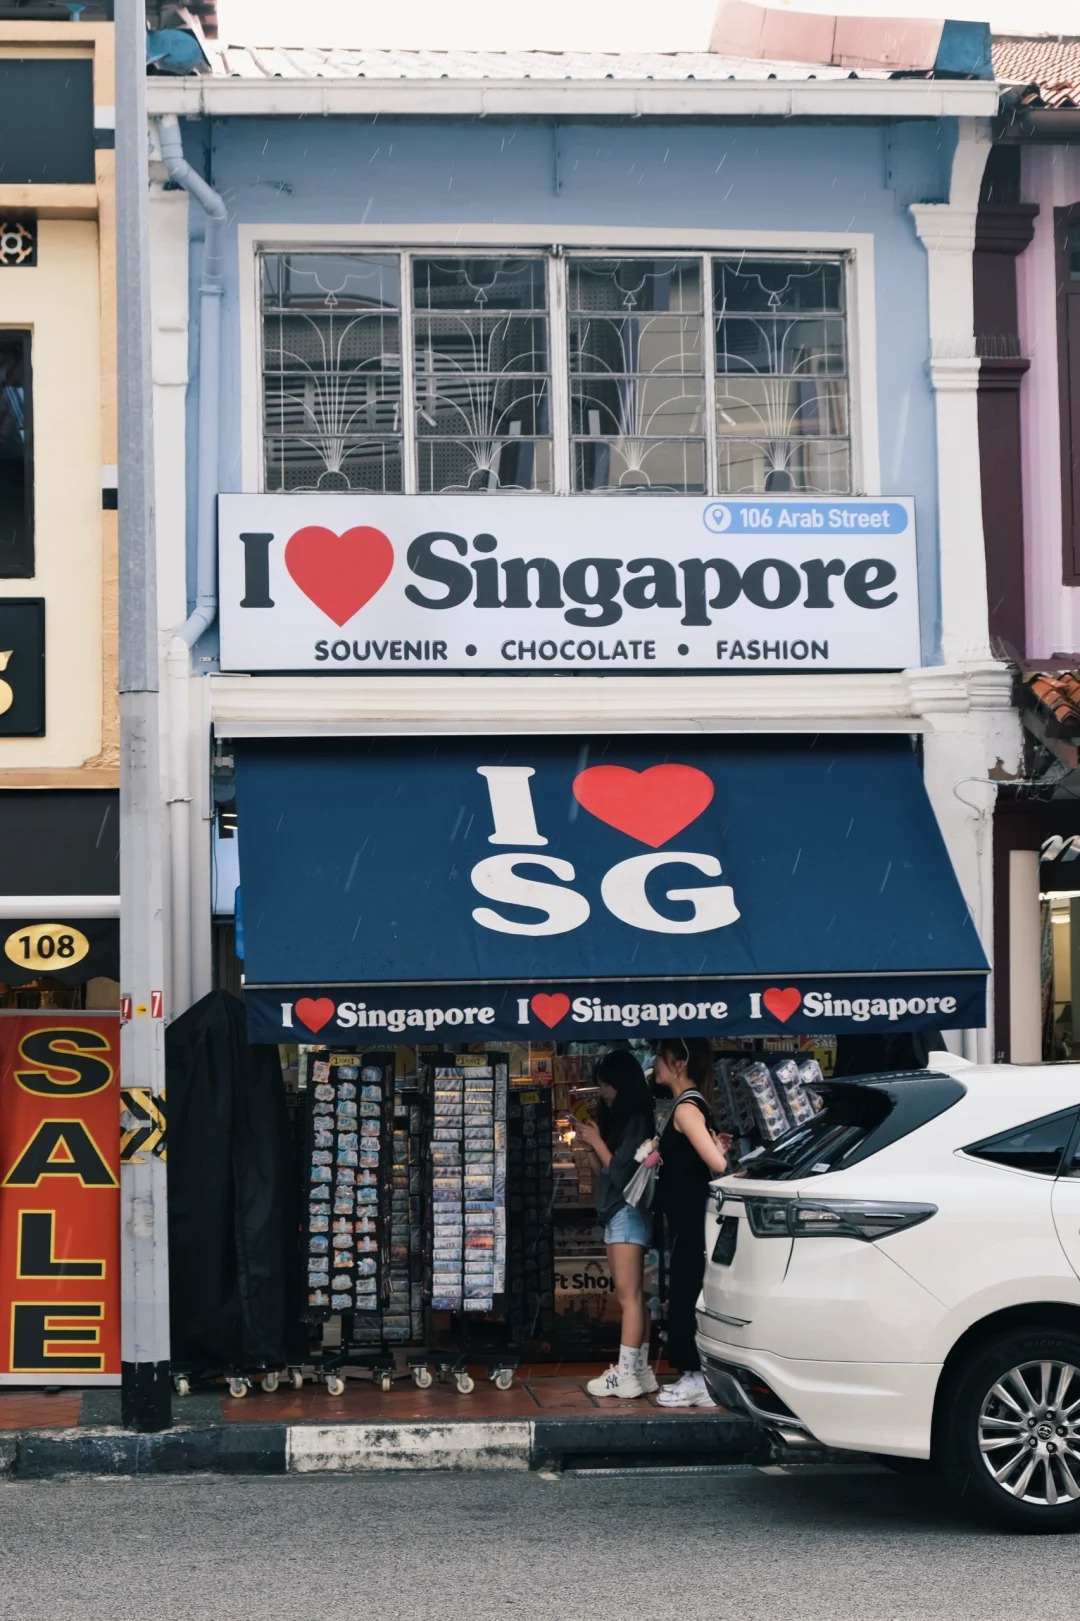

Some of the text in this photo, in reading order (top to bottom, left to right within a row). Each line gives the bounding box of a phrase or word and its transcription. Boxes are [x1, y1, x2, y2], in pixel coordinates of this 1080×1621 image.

[739, 507, 891, 529] 106 Arab Street
[240, 531, 898, 627] I Singapore
[315, 640, 829, 662] SOUVENIR CHOCOLATE FASHION
[476, 765, 549, 846] I
[470, 851, 741, 936] SG
[18, 934, 75, 959] 108
[281, 1002, 495, 1032] I Singapore
[517, 996, 728, 1026] I Singapore
[749, 991, 957, 1020] I Singapore
[1, 1027, 120, 1372] SALE
